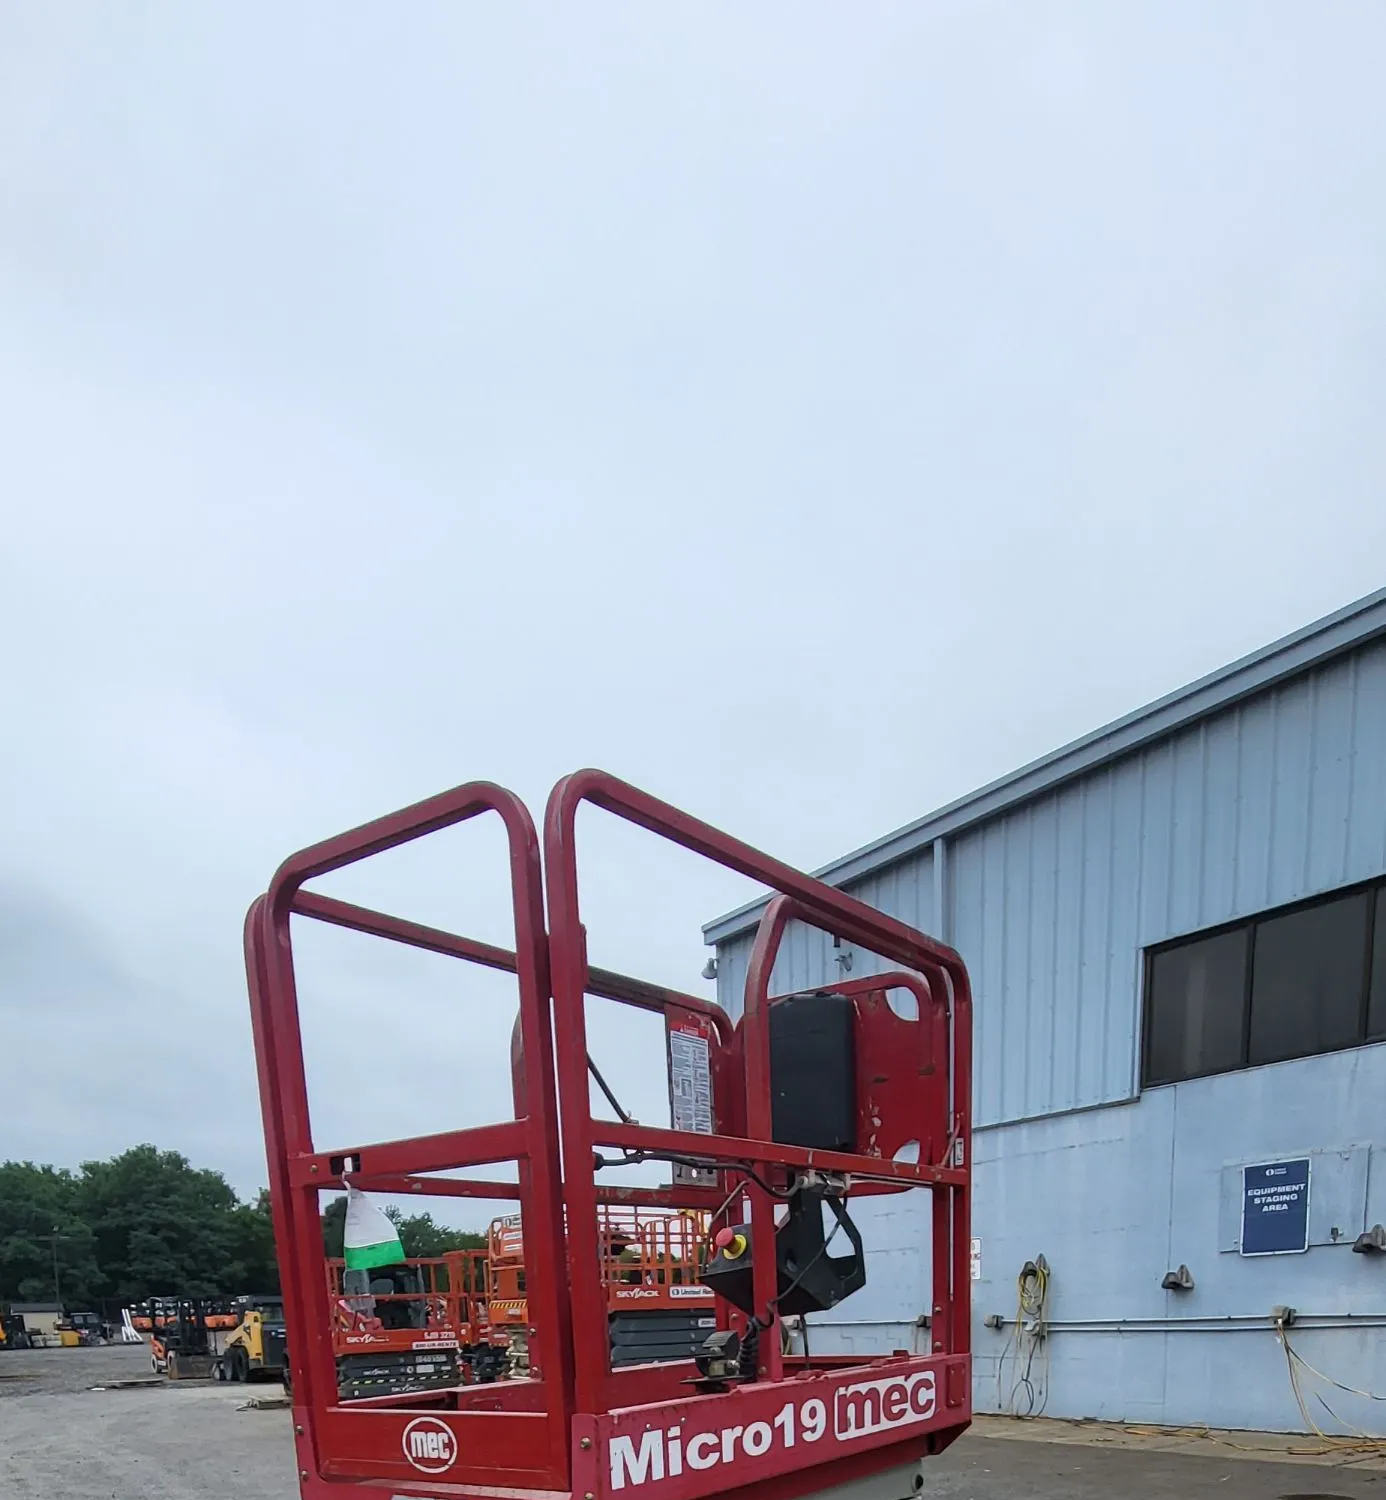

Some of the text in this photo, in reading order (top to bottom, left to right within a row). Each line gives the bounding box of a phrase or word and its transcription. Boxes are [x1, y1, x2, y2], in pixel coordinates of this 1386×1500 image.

[1247, 1184, 1306, 1196] EQUIPMENT
[1253, 1193, 1298, 1204] STAGING
[1262, 1204, 1288, 1212] AREA
[616, 1288, 660, 1299] SKYJACK
[411, 1431, 450, 1460] mec
[609, 1397, 827, 1491] Micro19
